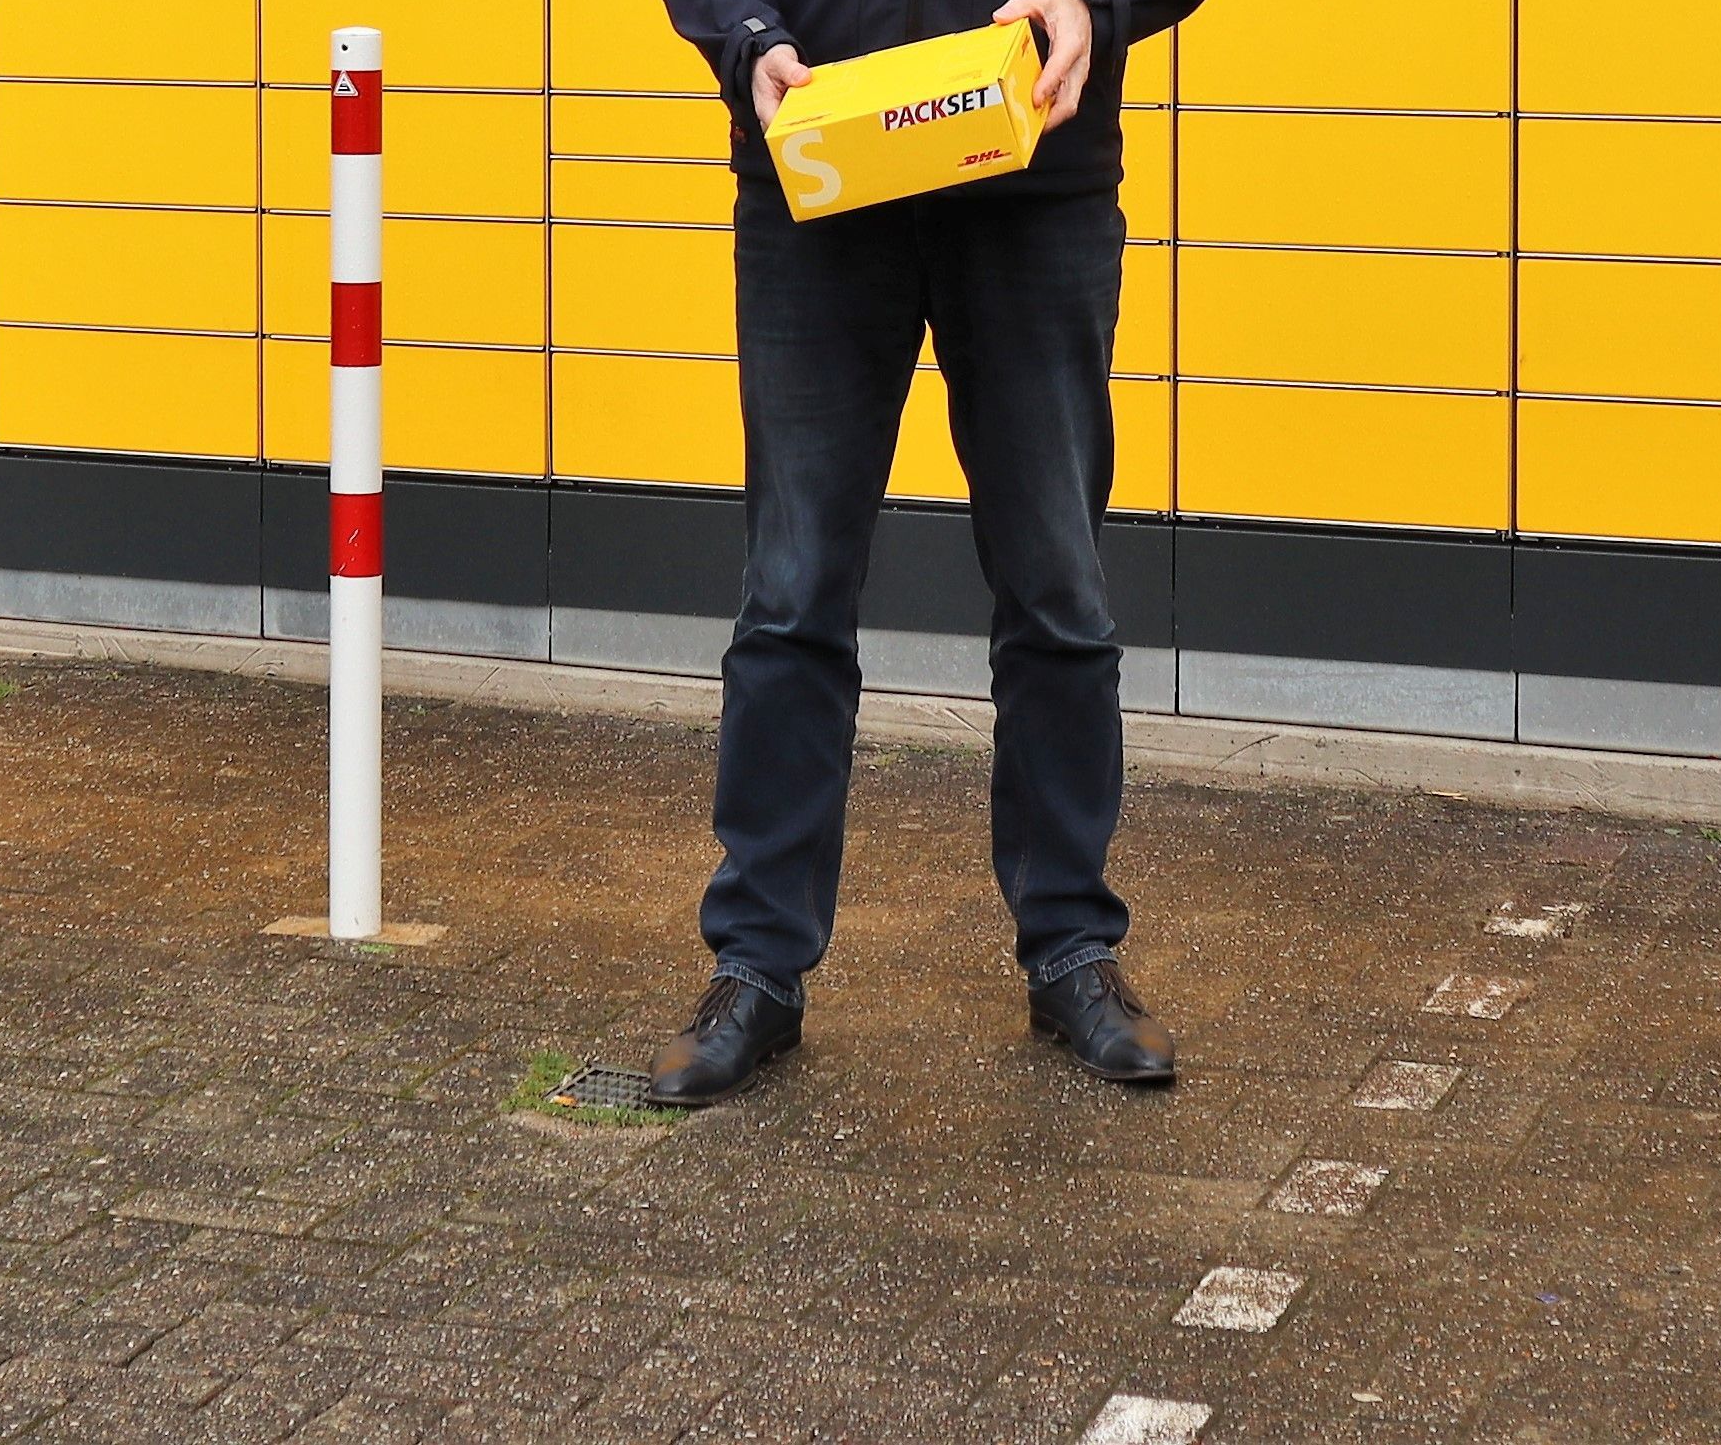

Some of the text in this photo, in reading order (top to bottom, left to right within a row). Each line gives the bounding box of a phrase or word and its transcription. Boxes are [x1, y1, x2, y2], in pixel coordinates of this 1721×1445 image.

[883, 87, 989, 132] PACKSET
[781, 129, 842, 209] S
[964, 148, 1005, 165] DHL
